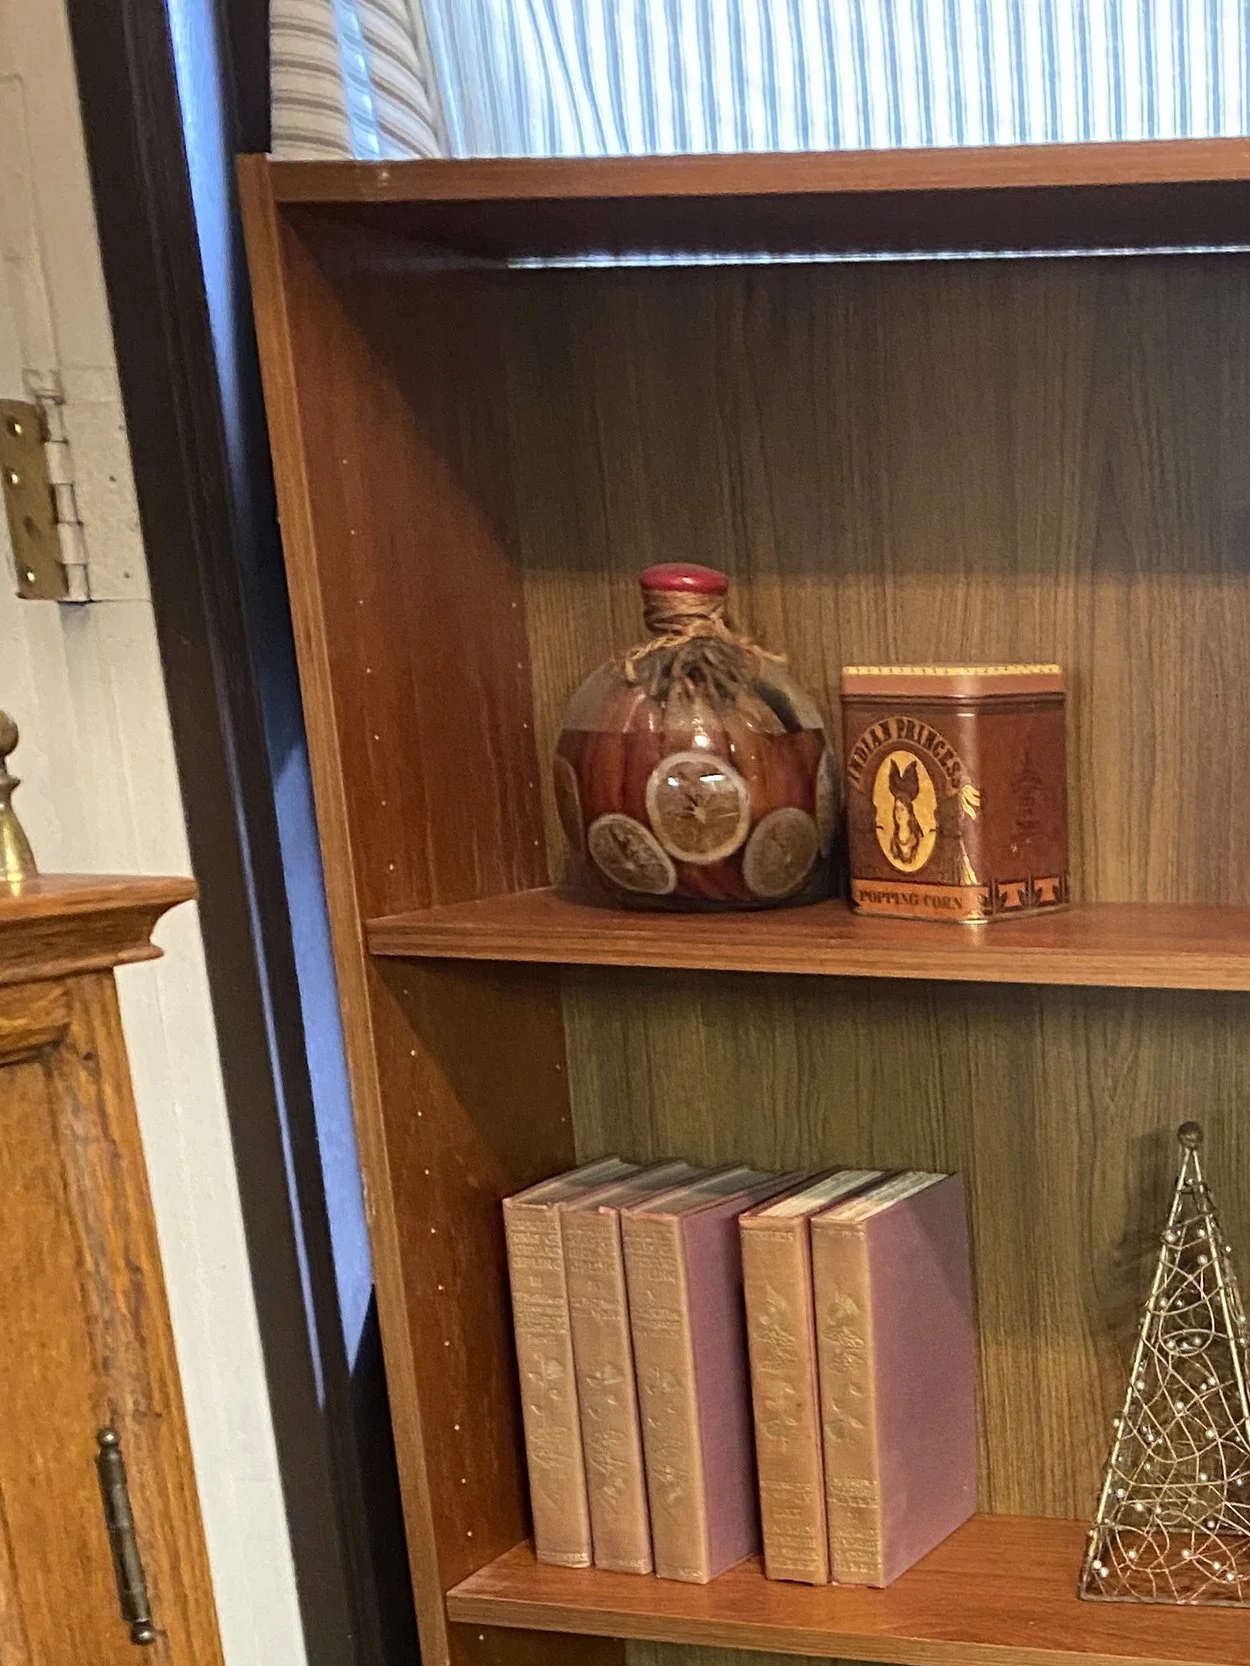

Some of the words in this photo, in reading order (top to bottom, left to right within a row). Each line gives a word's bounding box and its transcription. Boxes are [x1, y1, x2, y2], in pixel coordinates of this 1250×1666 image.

[847, 719, 892, 784] INDIAN
[897, 718, 961, 789] PRINCESS
[923, 893, 963, 909] CORN
